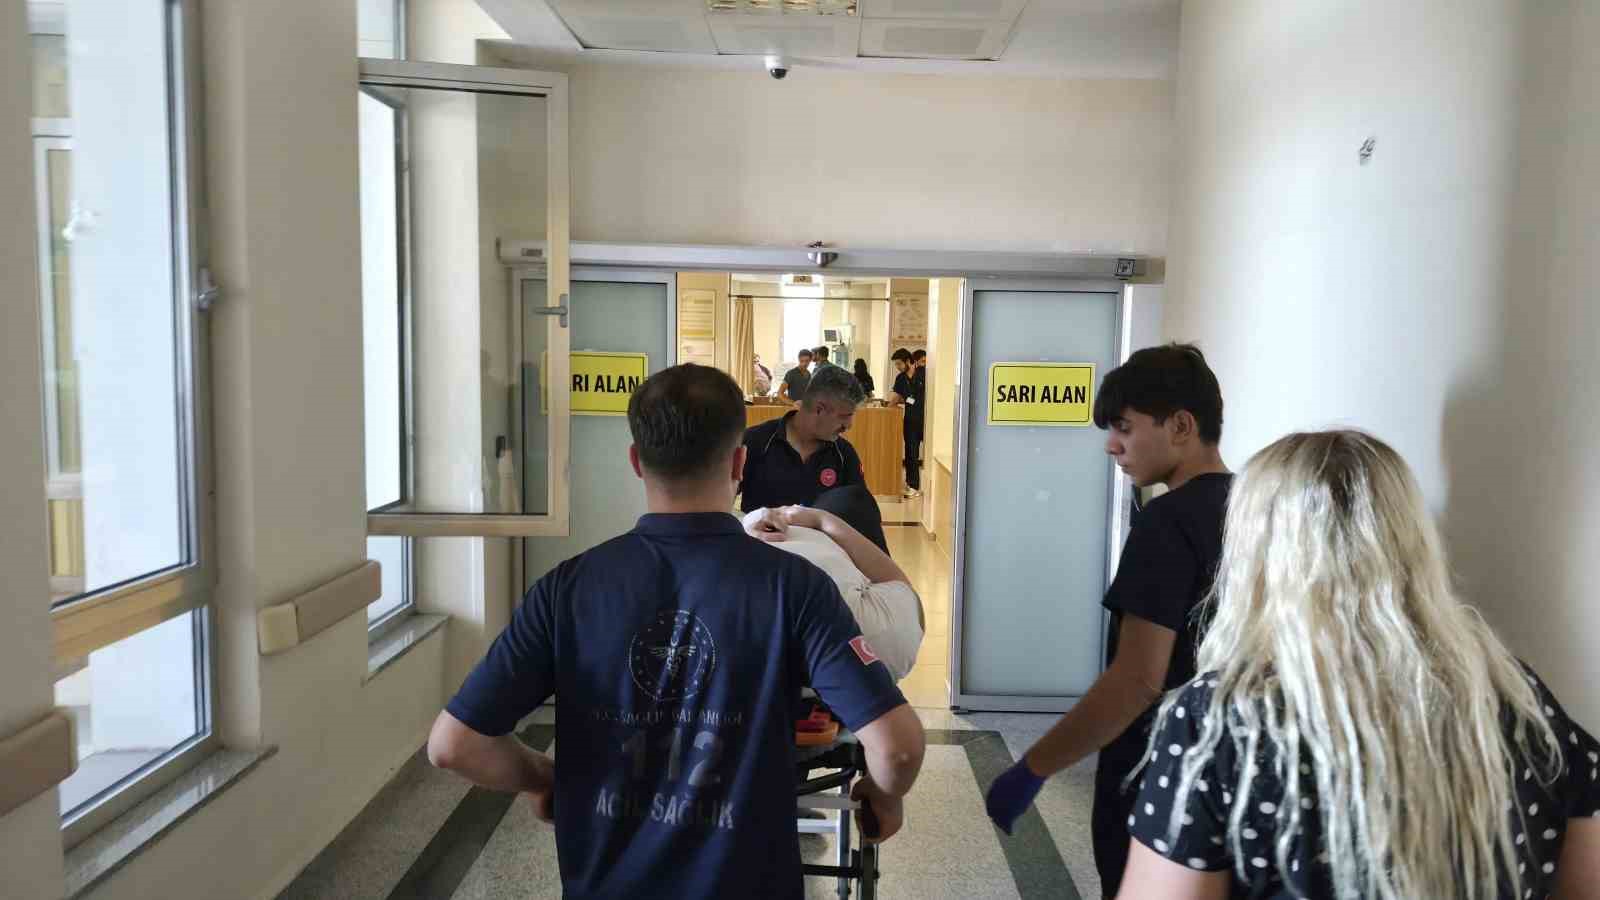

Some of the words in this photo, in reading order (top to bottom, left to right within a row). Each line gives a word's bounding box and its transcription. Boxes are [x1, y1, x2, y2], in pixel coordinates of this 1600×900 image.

[570, 374, 589, 392] RI
[594, 375, 639, 393] ALAN
[997, 385, 1036, 403] SARI
[1040, 386, 1086, 404] ALAN
[617, 729, 724, 787] 112
